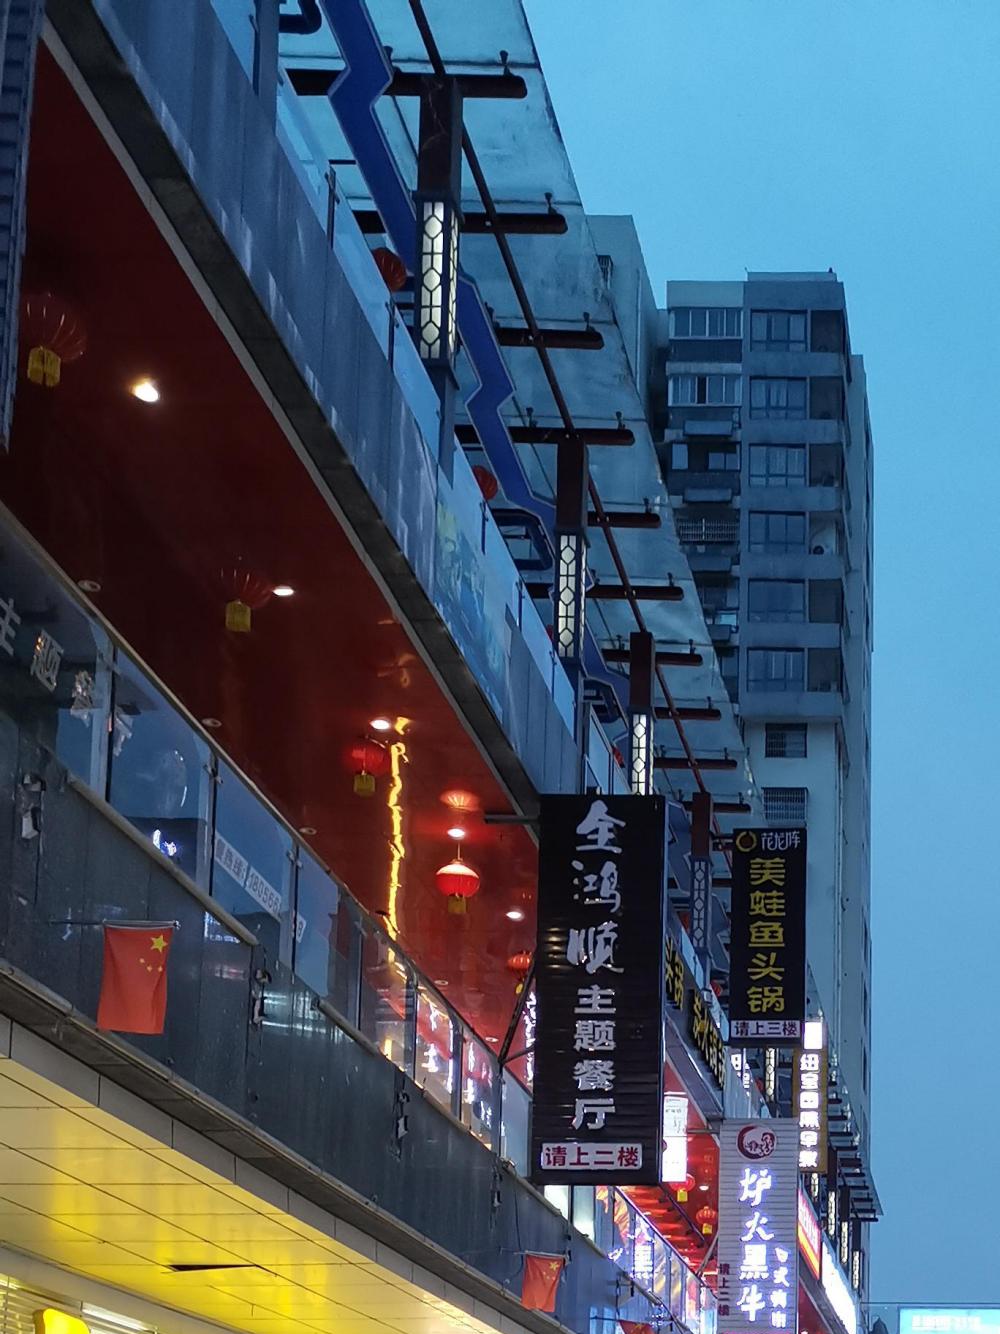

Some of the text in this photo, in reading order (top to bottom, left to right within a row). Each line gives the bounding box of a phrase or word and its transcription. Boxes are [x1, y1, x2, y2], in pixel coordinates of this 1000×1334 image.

[748, 856, 787, 1014] 美蛙鱼头锅
[734, 1021, 798, 1036] 请上三楼
[545, 1146, 638, 1167] 请上二楼
[737, 1168, 774, 1322] 炉火黑牛
